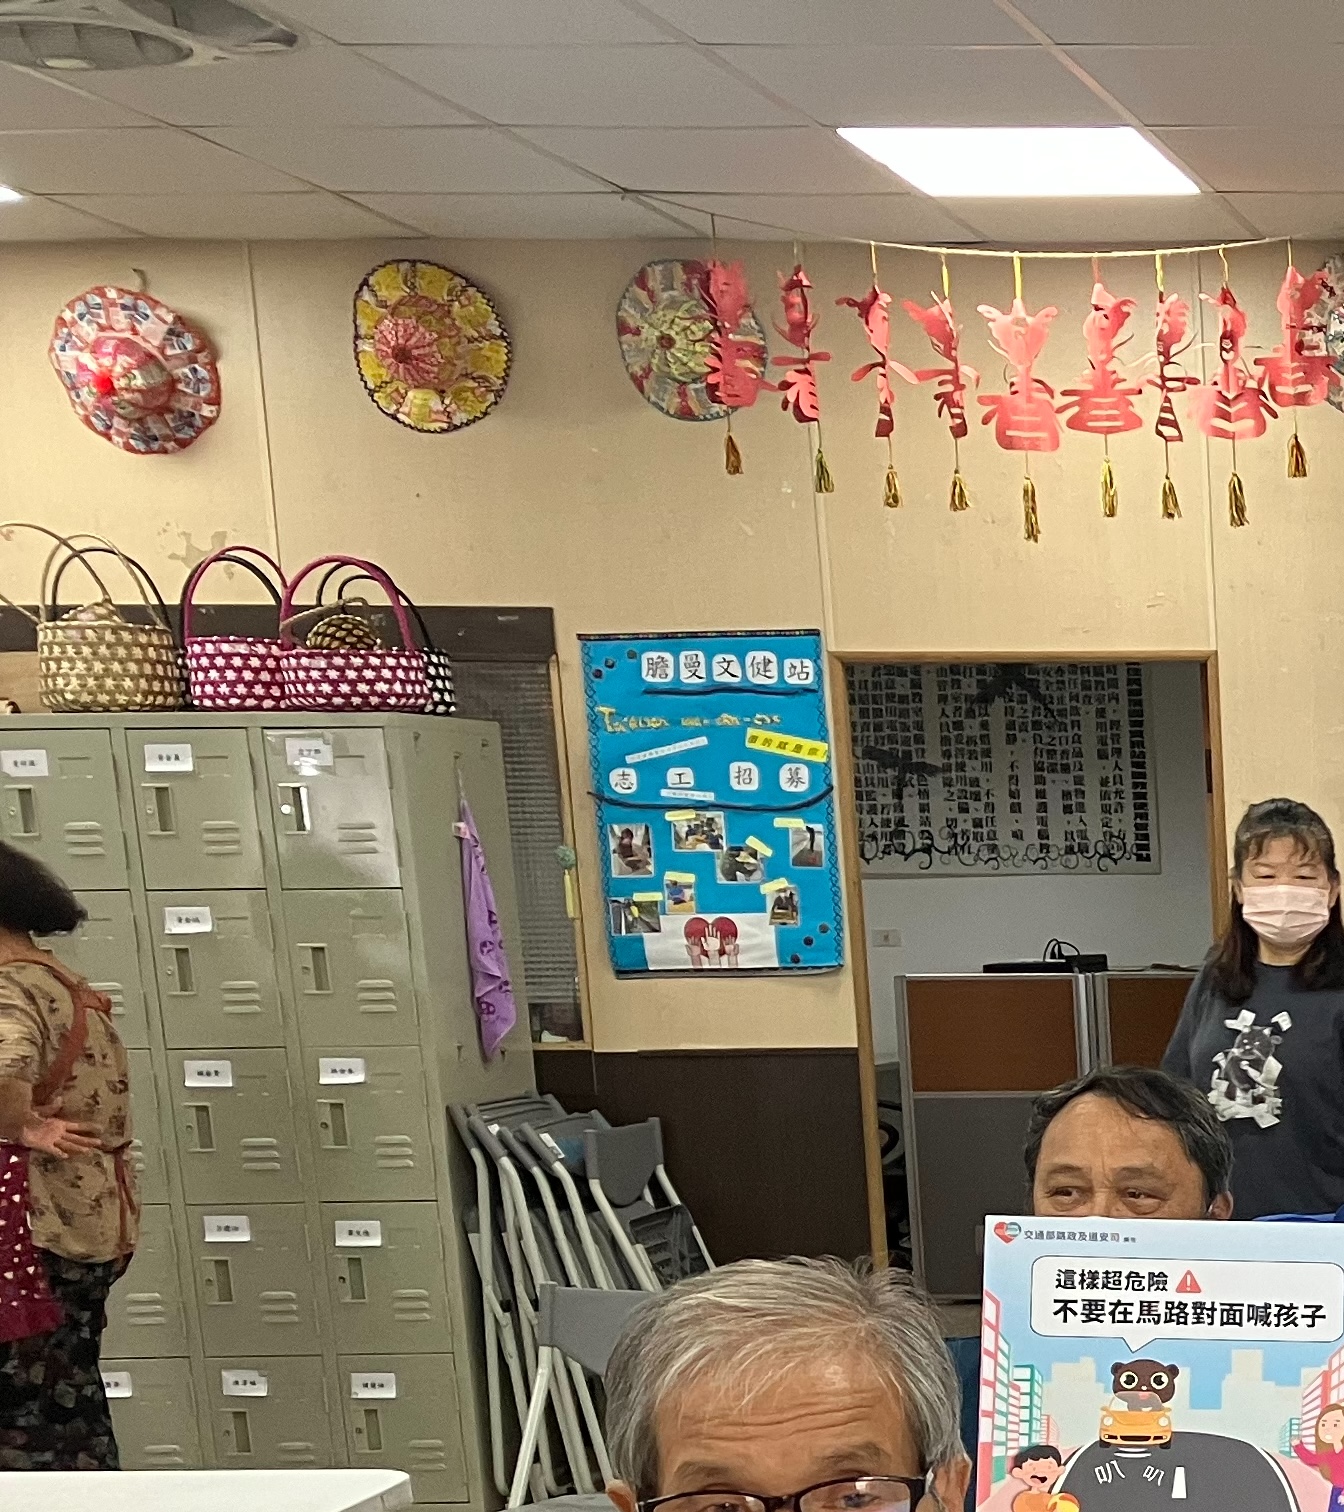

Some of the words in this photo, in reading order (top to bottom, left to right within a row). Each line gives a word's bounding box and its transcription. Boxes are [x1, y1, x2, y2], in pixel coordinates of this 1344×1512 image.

[1055, 1268, 1168, 1292] 這樣超危險
[1052, 1298, 1327, 1328] 不要在馬路對面喊孩子
